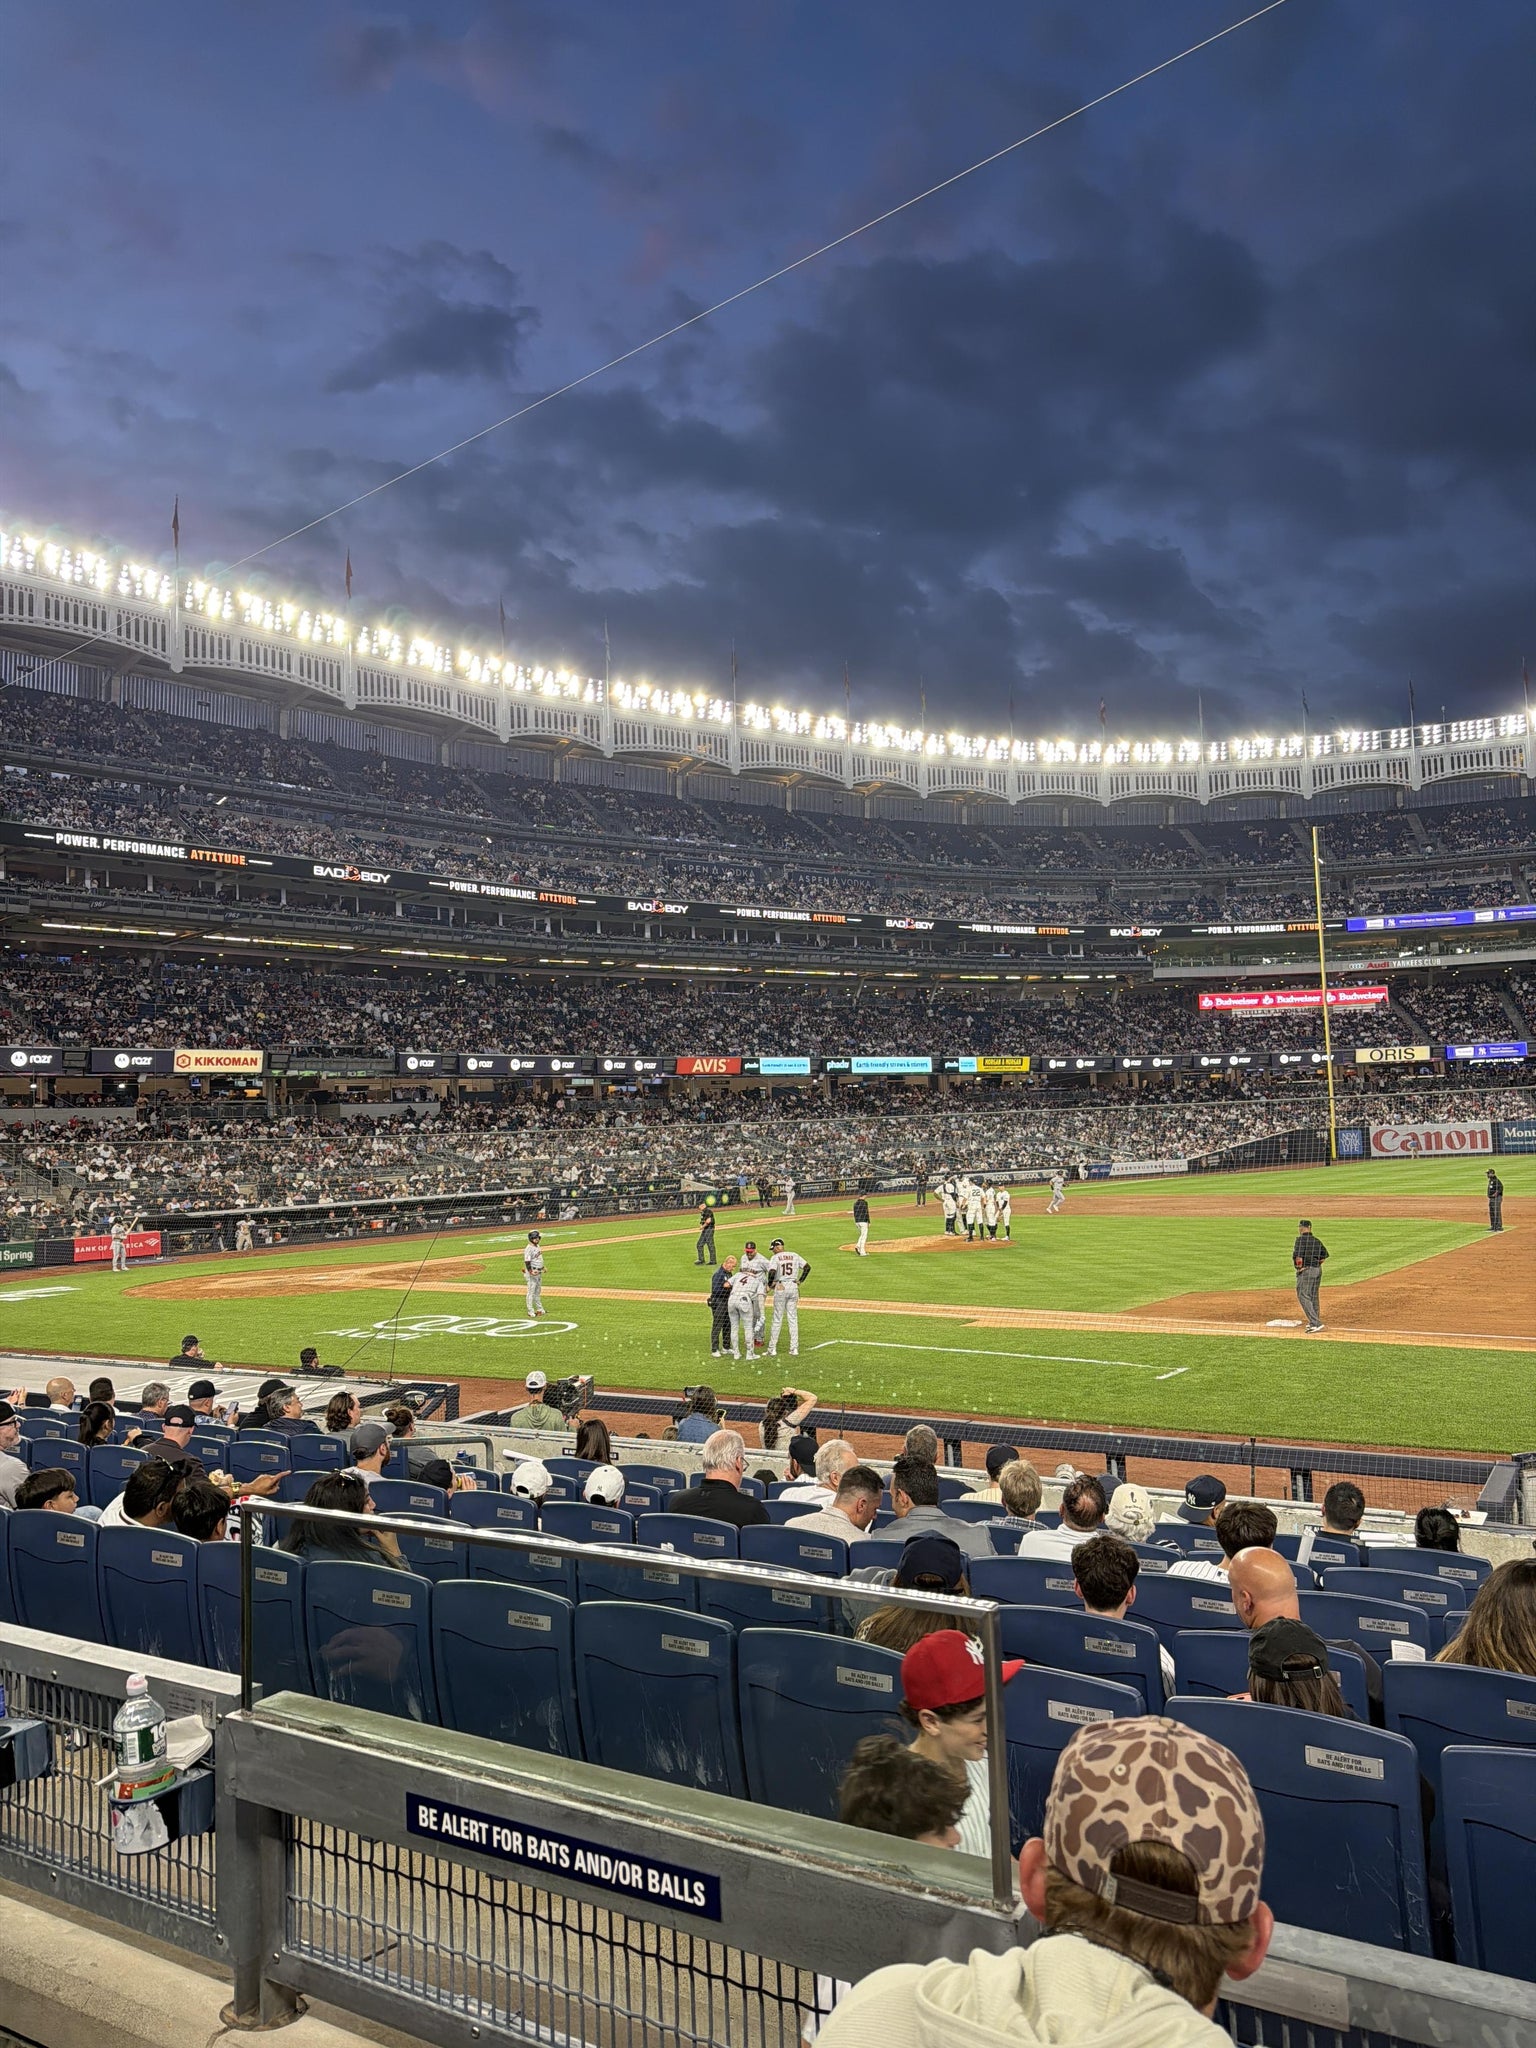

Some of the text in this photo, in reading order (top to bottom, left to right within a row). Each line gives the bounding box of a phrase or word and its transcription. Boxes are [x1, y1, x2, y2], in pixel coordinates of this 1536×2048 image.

[56, 833, 248, 866] POWER. PERFORMANCE. ATTITUDE.
[360, 871, 391, 884] BOY
[449, 881, 578, 905] POWER. PERFORMANCE. ATTITUDE.
[664, 904, 689, 914] BOY
[737, 908, 847, 923] POWER. PERFORMANCE. ATTITUDE.
[915, 921, 935, 930] BOY
[1141, 928, 1163, 936] BOY
[1366, 958, 1441, 969] Audi YANKEES CLUB
[1215, 997, 1259, 1006] Budweiser
[1277, 995, 1321, 1004] Budweiser
[1338, 991, 1386, 1001] Budweiser
[29, 1055, 53, 1064] razr
[1369, 1048, 1415, 1061] ORIS
[131, 1056, 152, 1065] razr
[194, 1056, 258, 1066] KIKKOMAN
[692, 1058, 727, 1073] AVIS
[1341, 1132, 1359, 1140] NEW
[1372, 1129, 1489, 1153] Canon
[1341, 1138, 1361, 1147] YORK
[972, 1189, 981, 1197] 22
[75, 1245, 97, 1253] BANK
[3, 1250, 34, 1263] Spring
[781, 1262, 793, 1276] 15
[738, 1275, 748, 1286] 4
[1325, 1753, 1362, 1766] BE ALERT FOR
[1317, 1758, 1372, 1774] BATS AND/OR BALLS
[418, 1804, 706, 1907] BE ALERT FOR BATS AND/OR BALLS
